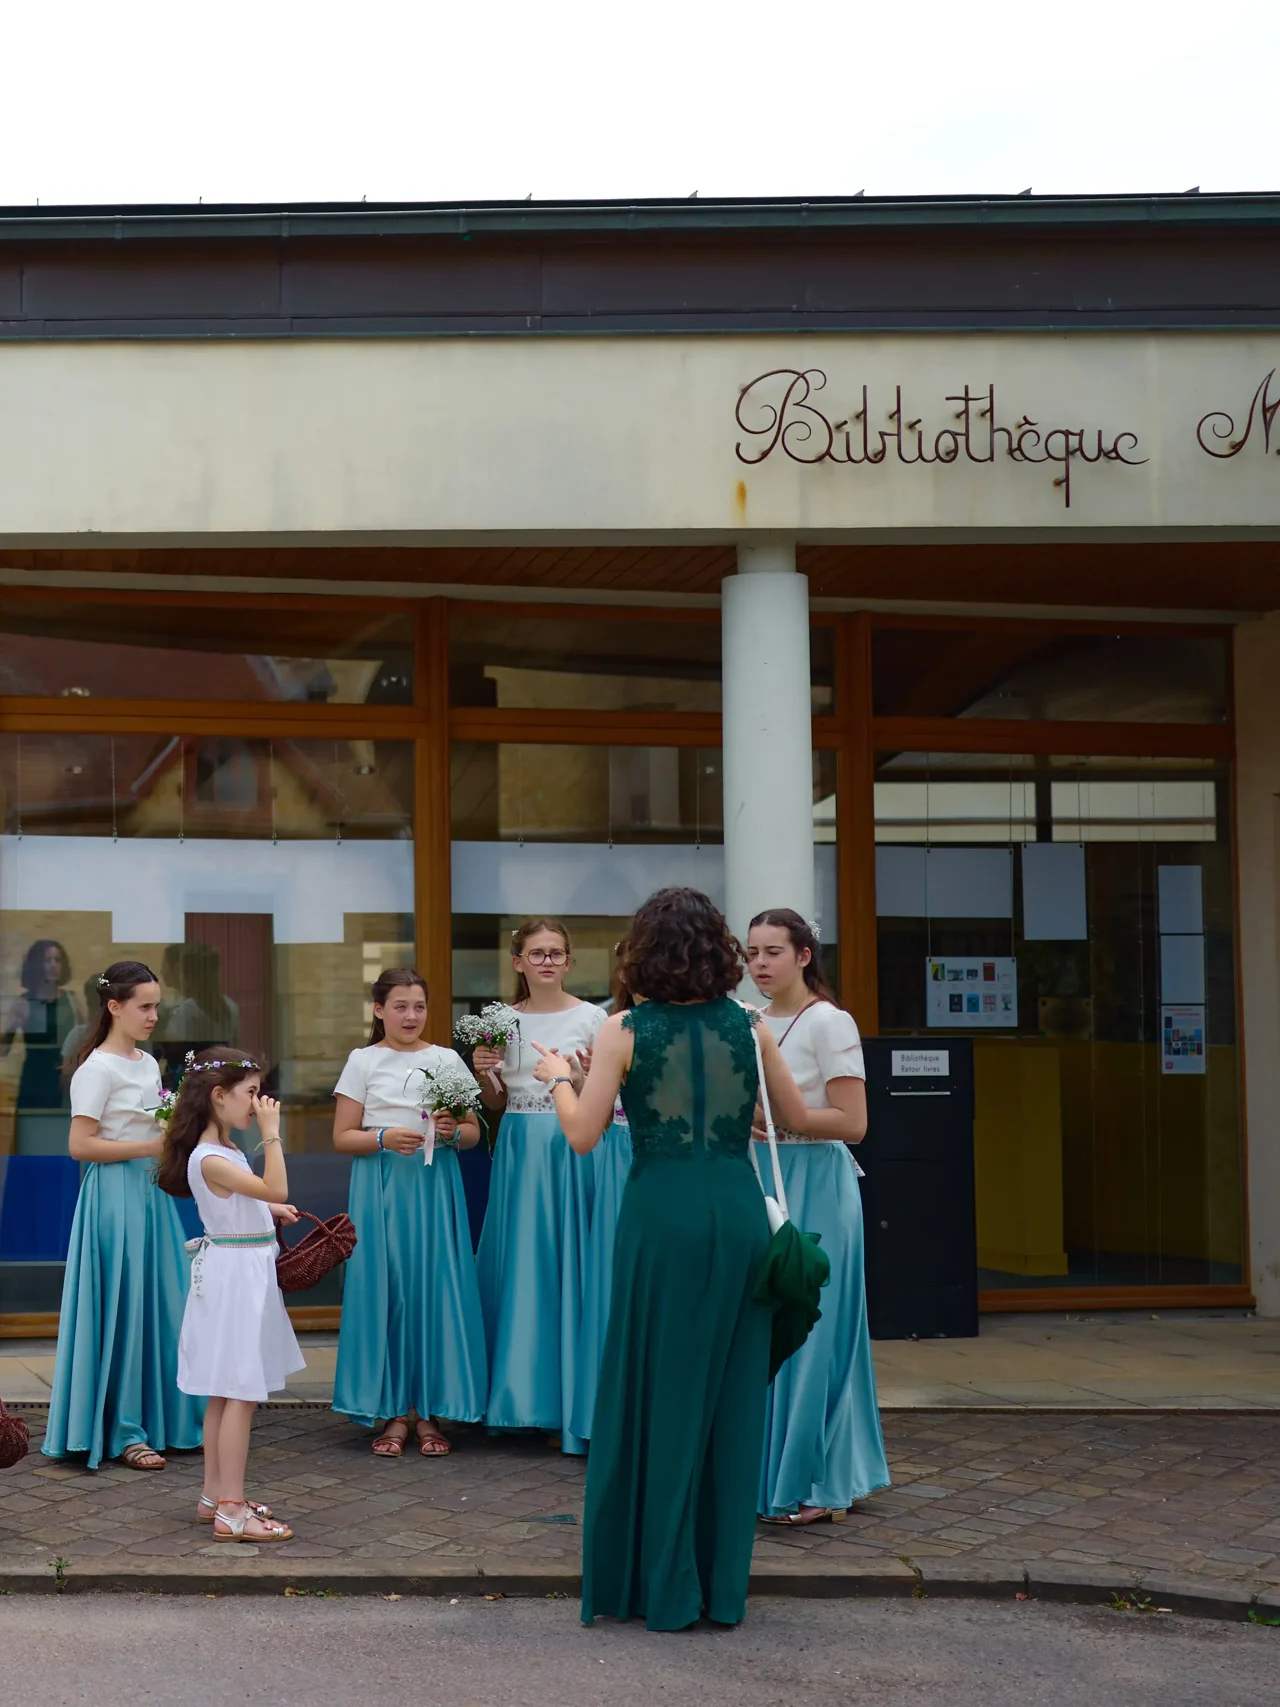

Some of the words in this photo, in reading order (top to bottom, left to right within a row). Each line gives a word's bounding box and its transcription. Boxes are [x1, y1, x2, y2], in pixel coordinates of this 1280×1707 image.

[734, 369, 1150, 508] Bibliothèque
[901, 1065, 921, 1073] Retour
[923, 1065, 941, 1073] livres
